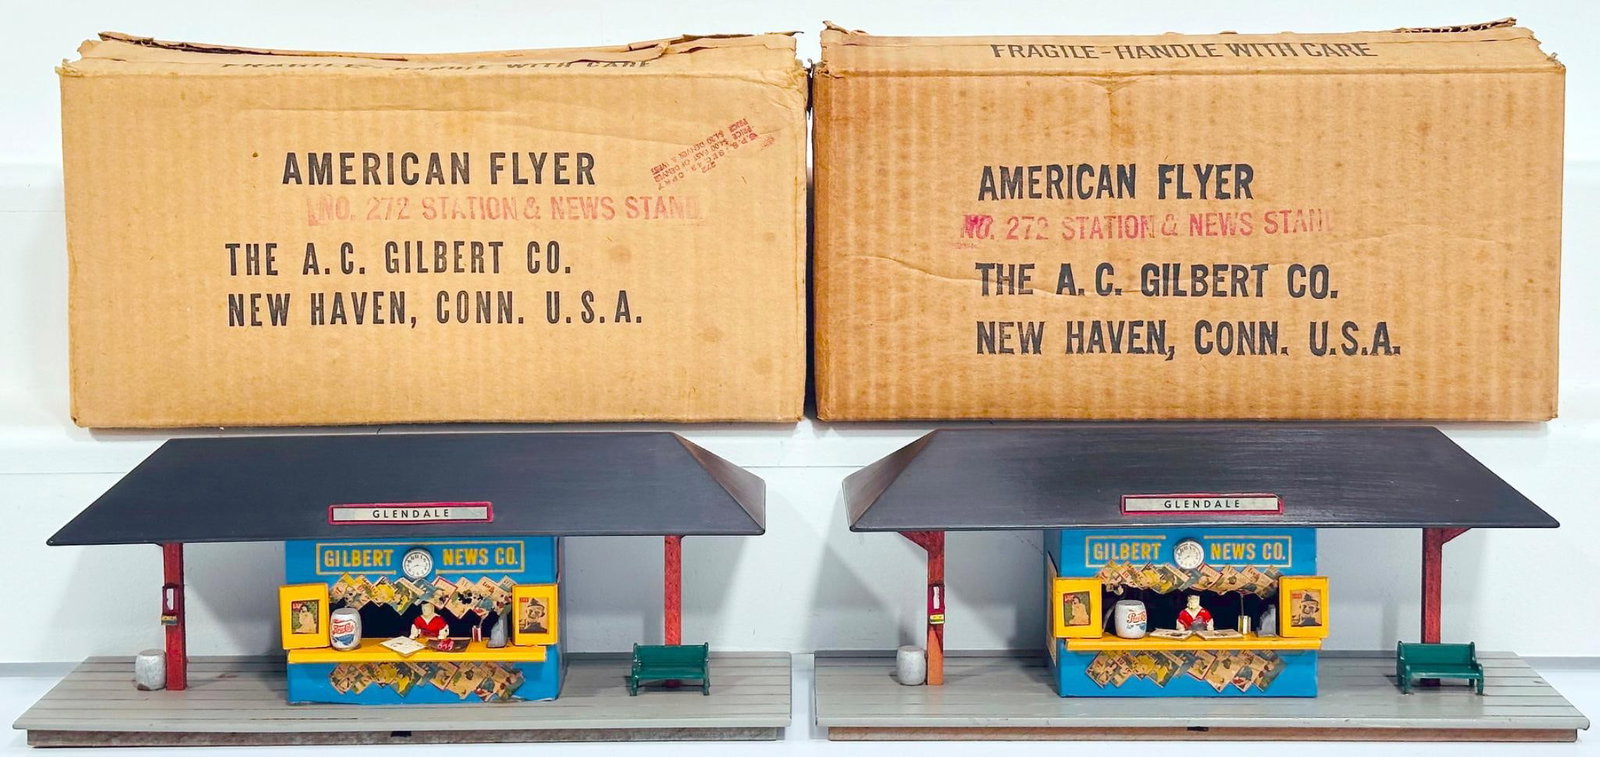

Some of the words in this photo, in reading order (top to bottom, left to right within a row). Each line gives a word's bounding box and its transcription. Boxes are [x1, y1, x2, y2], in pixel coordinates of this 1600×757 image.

[1226, 43, 1303, 58] WITH
[1304, 43, 1379, 57] CARE
[282, 152, 470, 186] AMERICAN
[490, 152, 596, 185] FLYER
[977, 163, 1136, 202] AMERICAN
[1158, 163, 1254, 200] FLYER
[366, 196, 411, 221] 272
[422, 195, 517, 222] STATION
[522, 196, 542, 221] &
[551, 195, 617, 221] NEWS
[1006, 216, 1049, 241] 272
[1061, 214, 1155, 241] STATION
[1161, 213, 1179, 237] &
[1189, 210, 1253, 238] NEWS
[224, 242, 279, 276] THE
[385, 240, 504, 274] GILBERT
[527, 240, 571, 274] CO.
[975, 262, 1035, 297] THE
[1140, 262, 1269, 298] GILBERT
[1287, 263, 1339, 300] CO.
[228, 293, 291, 327] NEW
[310, 291, 417, 329] HAVEN,
[436, 290, 524, 325] CONN.
[546, 290, 643, 325] U.S.A.
[976, 320, 1045, 355] NEW
[1065, 319, 1175, 362] HAVEN,
[1194, 319, 1289, 357] CONN.
[1309, 320, 1401, 357] U.S.A.
[372, 508, 450, 520] GLENDALE
[1163, 498, 1241, 510] GLENDALE
[323, 548, 395, 568] GILBERT
[442, 547, 489, 567] NEWS
[495, 546, 518, 565] CO.
[1093, 543, 1162, 562] GILBERT
[1210, 542, 1256, 561] NEWS
[1262, 542, 1287, 561] CO.
